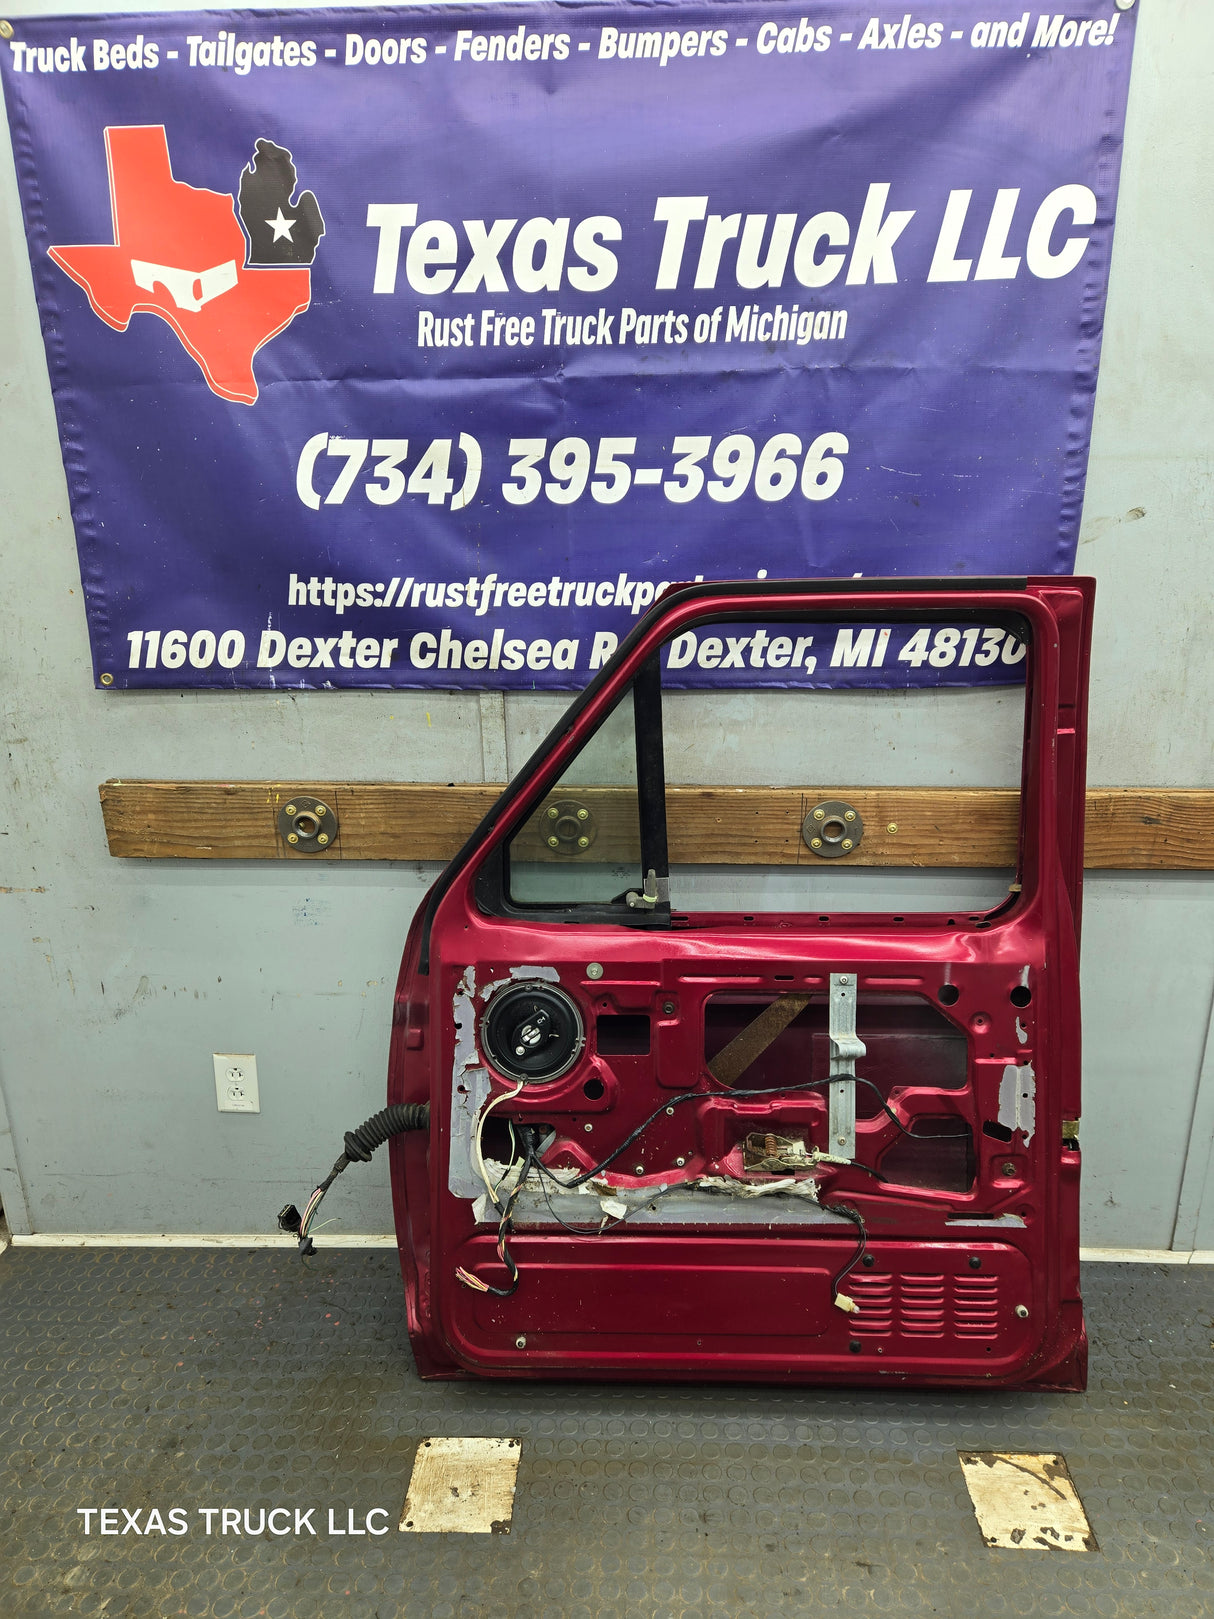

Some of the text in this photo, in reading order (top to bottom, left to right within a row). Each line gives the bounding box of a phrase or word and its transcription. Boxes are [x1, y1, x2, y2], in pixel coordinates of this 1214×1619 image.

[9, 37, 87, 73] Truck
[93, 34, 160, 71] Beds
[186, 30, 317, 76] Tailgates
[344, 33, 428, 66] Doors
[453, 25, 571, 62] Fenders
[597, 26, 729, 67] Bumpers
[756, 17, 833, 55] Cabs
[856, 13, 945, 50] Axles
[970, 11, 1029, 49] and
[1030, 12, 1121, 48] More!
[365, 182, 1097, 295] Texas Truck LLC
[417, 303, 848, 348] Rust Free Truck Parts of Michigan
[296, 431, 850, 511] (734) 395-3966
[126, 629, 246, 669] 11600
[256, 628, 399, 669] Dexter
[409, 628, 580, 671] Chelsea
[666, 629, 818, 675] Dexter,
[829, 628, 892, 668] MI
[897, 627, 1026, 668] 48130
